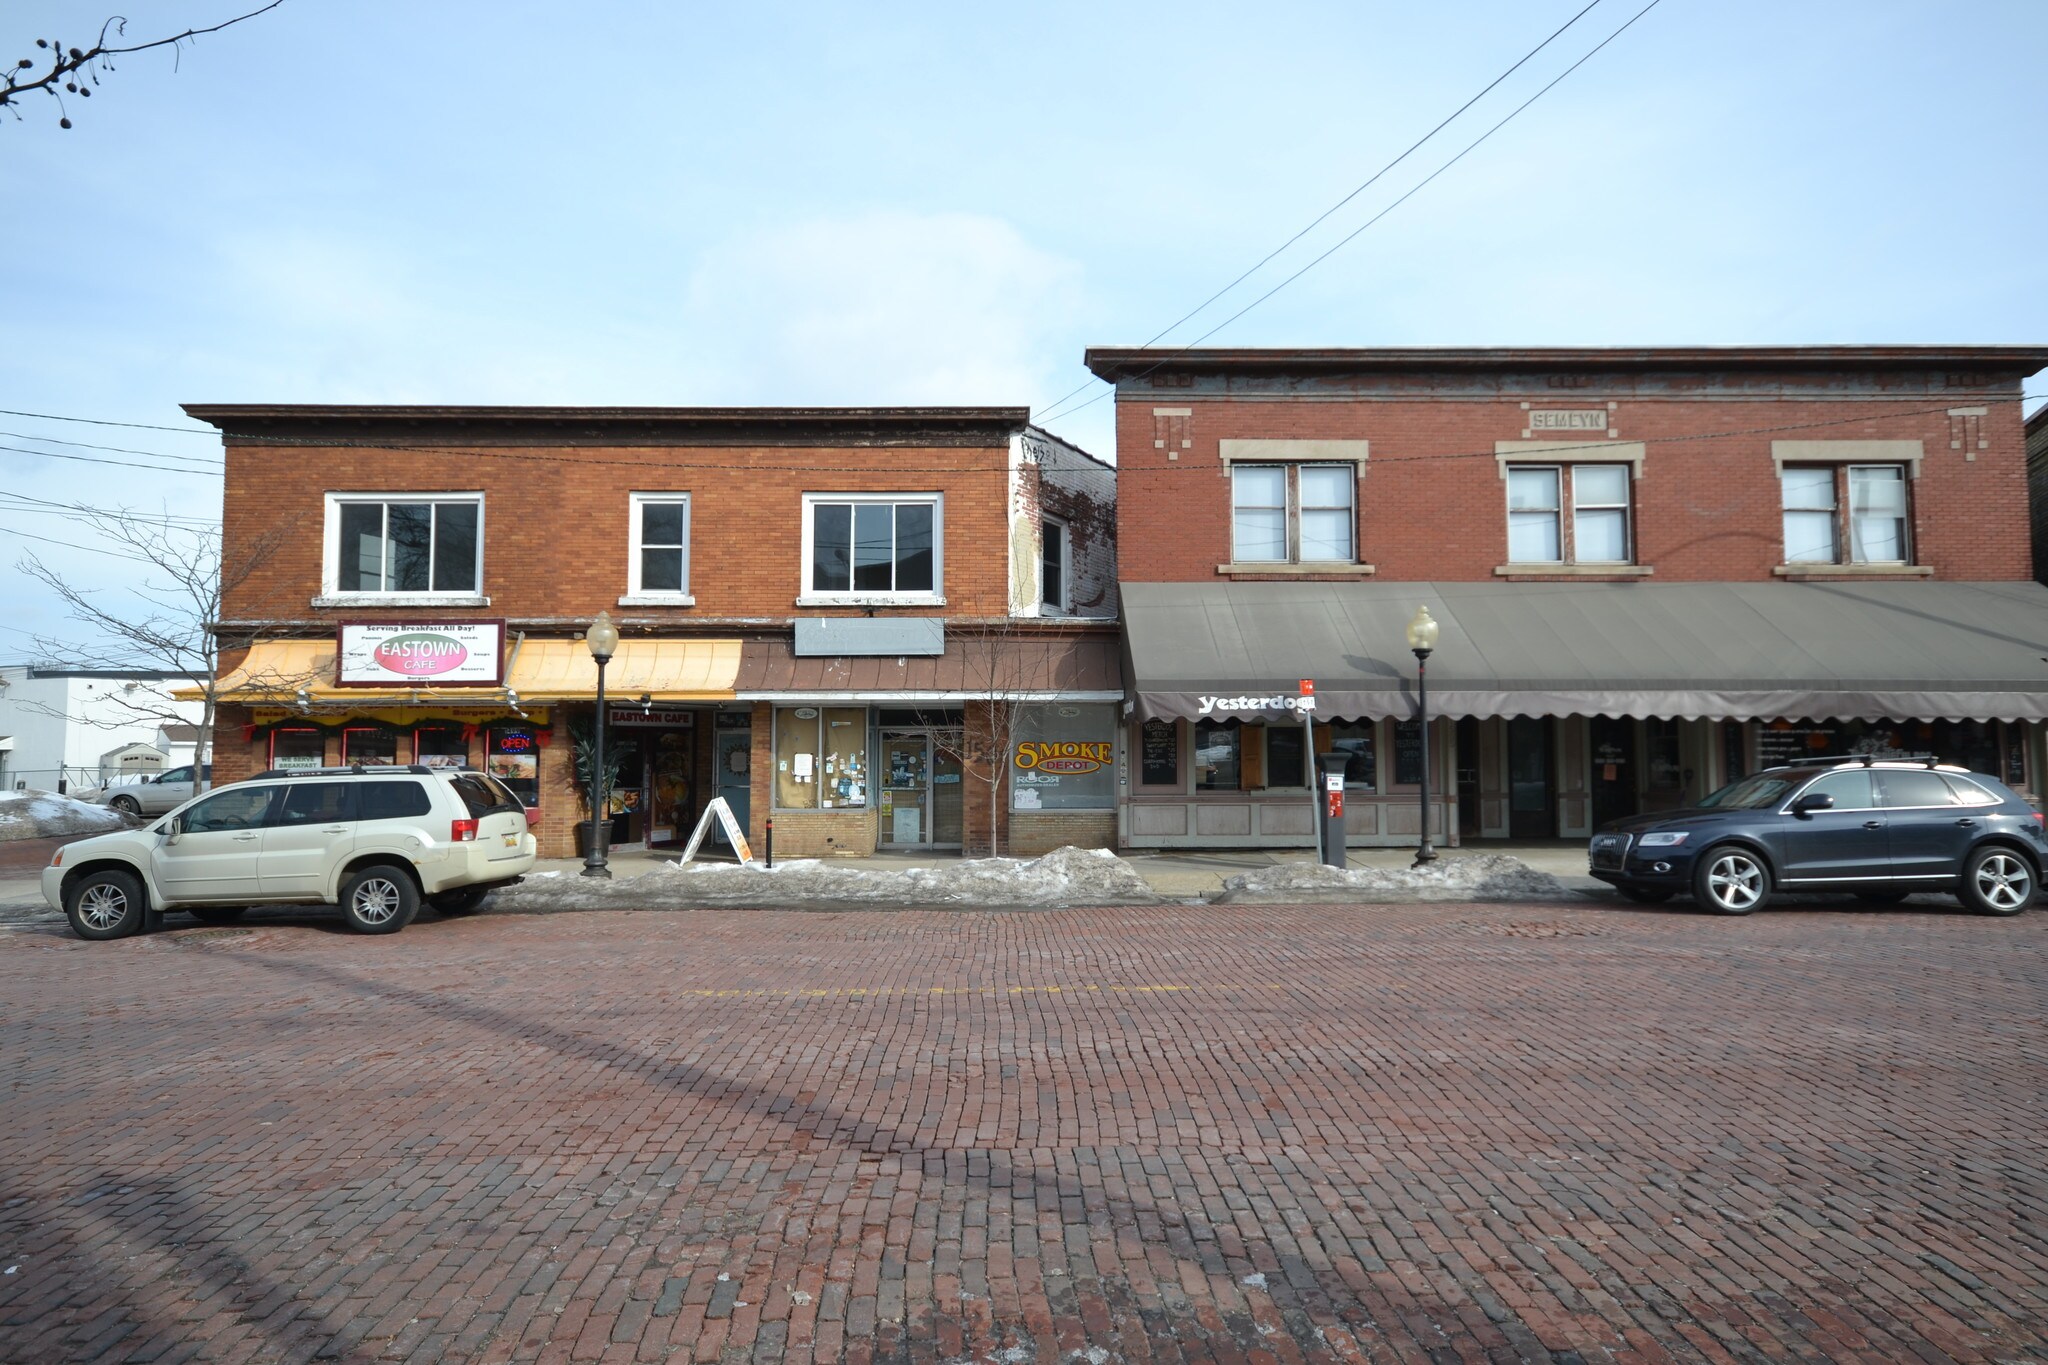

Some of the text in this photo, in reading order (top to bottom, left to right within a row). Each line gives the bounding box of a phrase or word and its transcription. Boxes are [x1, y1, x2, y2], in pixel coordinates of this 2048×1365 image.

[1533, 412, 1602, 428] SEMEYN
[381, 641, 461, 658] EASTOWN
[404, 660, 436, 669] CAFE
[612, 712, 689, 723] EASTOWN CAFE
[501, 738, 530, 748] OPEN
[1015, 742, 1113, 769] SMOKE
[1046, 761, 1090, 770] DEPOT
